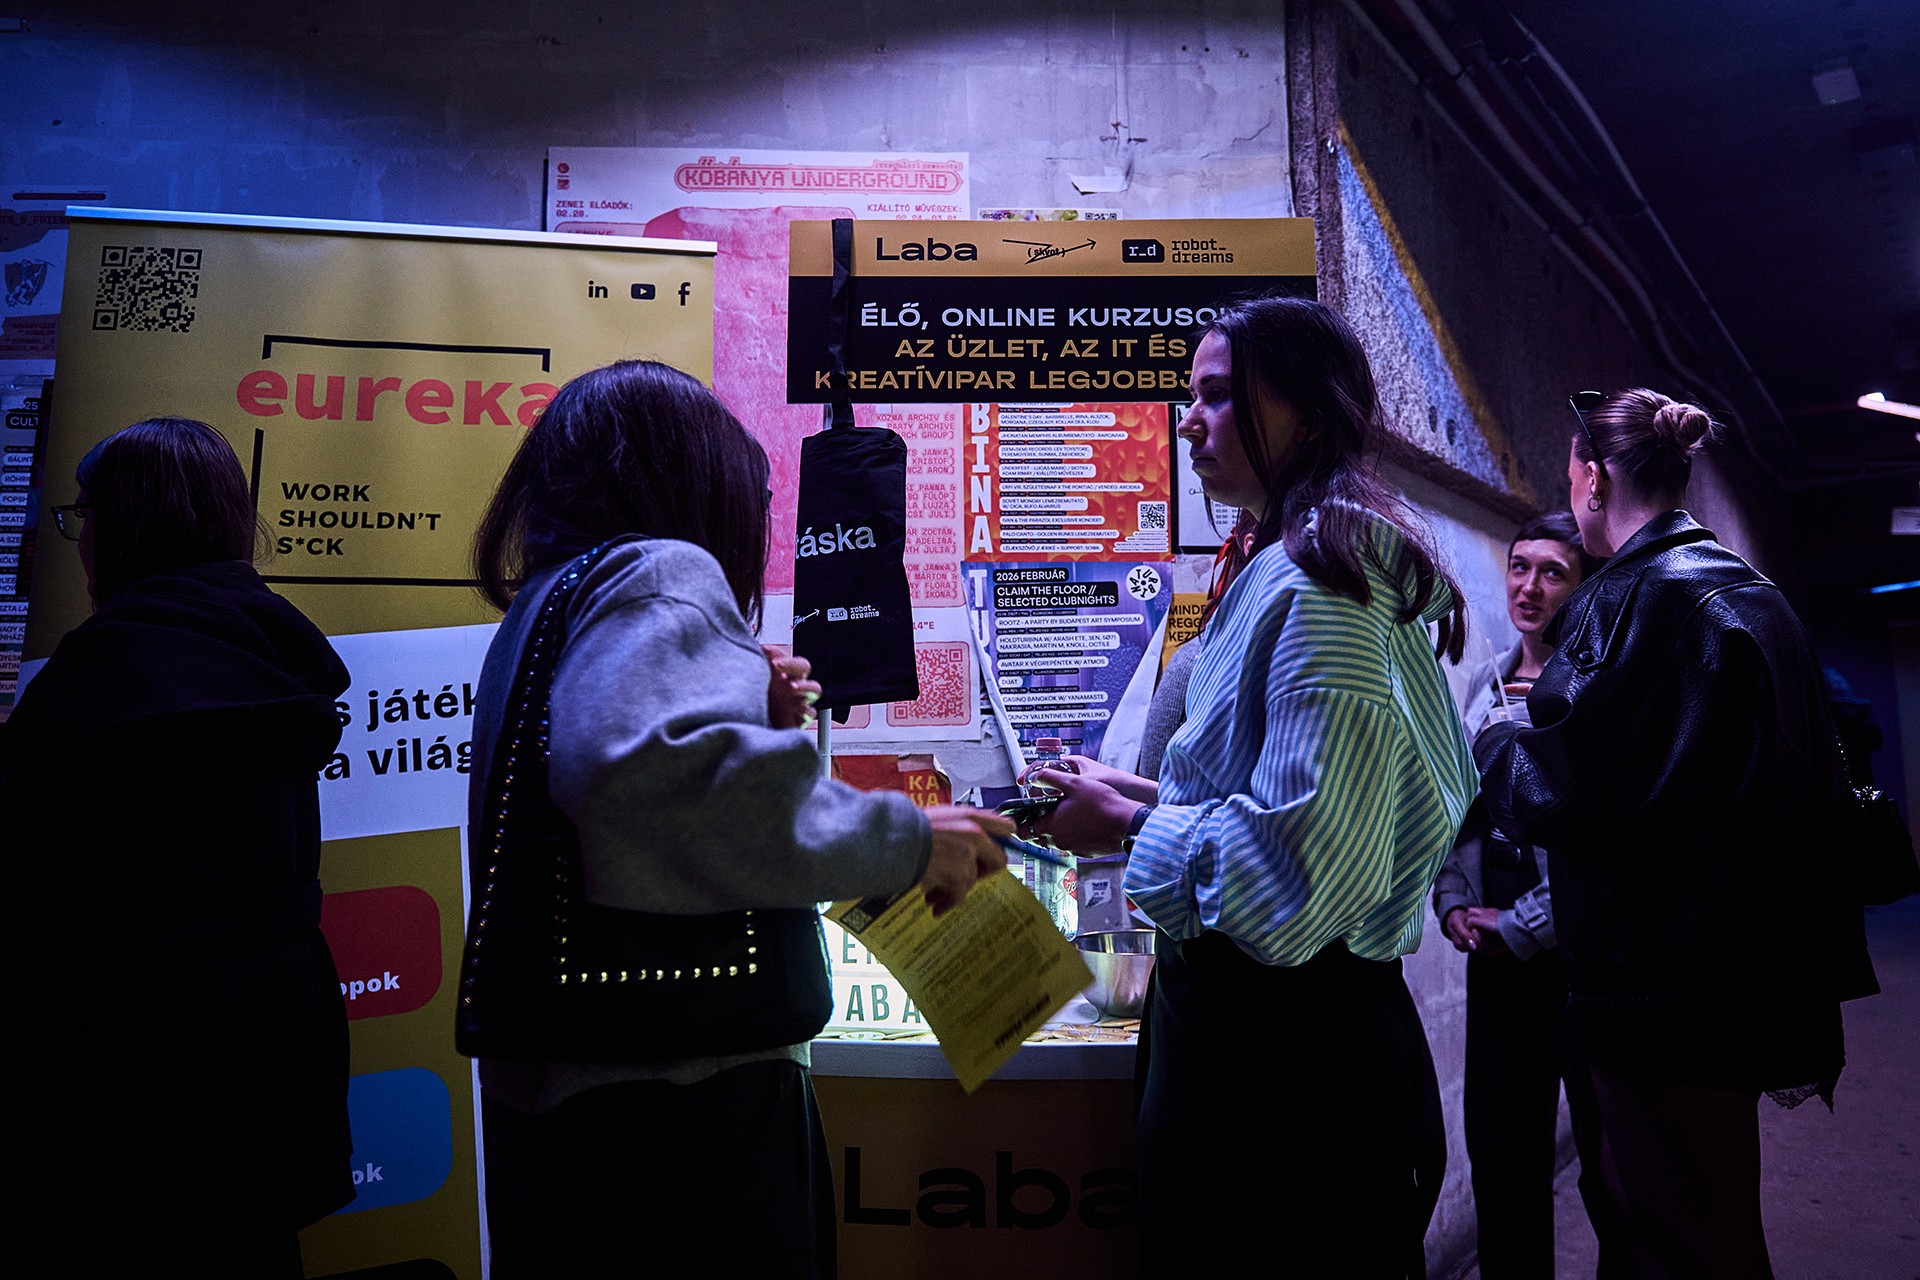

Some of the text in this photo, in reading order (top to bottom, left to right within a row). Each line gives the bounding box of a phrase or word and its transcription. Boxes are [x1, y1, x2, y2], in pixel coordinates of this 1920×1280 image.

[791, 170, 948, 189] UNDERGROUND
[556, 200, 584, 208] ZENEI
[877, 237, 978, 261] Laba
[1171, 251, 1235, 264] dreams
[860, 302, 1232, 331] ÉLŐ, ONLINE KURZUSO
[894, 333, 1188, 362] AZ ÜZLET, AZ IT ÉS
[281, 482, 371, 503] WORK
[280, 508, 441, 531] SHOULDN'T
[996, 569, 1066, 582] 2026 FEBRUÁR
[996, 587, 1030, 597] CLAIM
[1031, 586, 1052, 596] THE
[1053, 585, 1087, 595] FLOOR
[998, 595, 1116, 608] SELECTED CLUBNIGHTS
[909, 775, 940, 791] KA
[843, 1147, 1137, 1230] Laba
